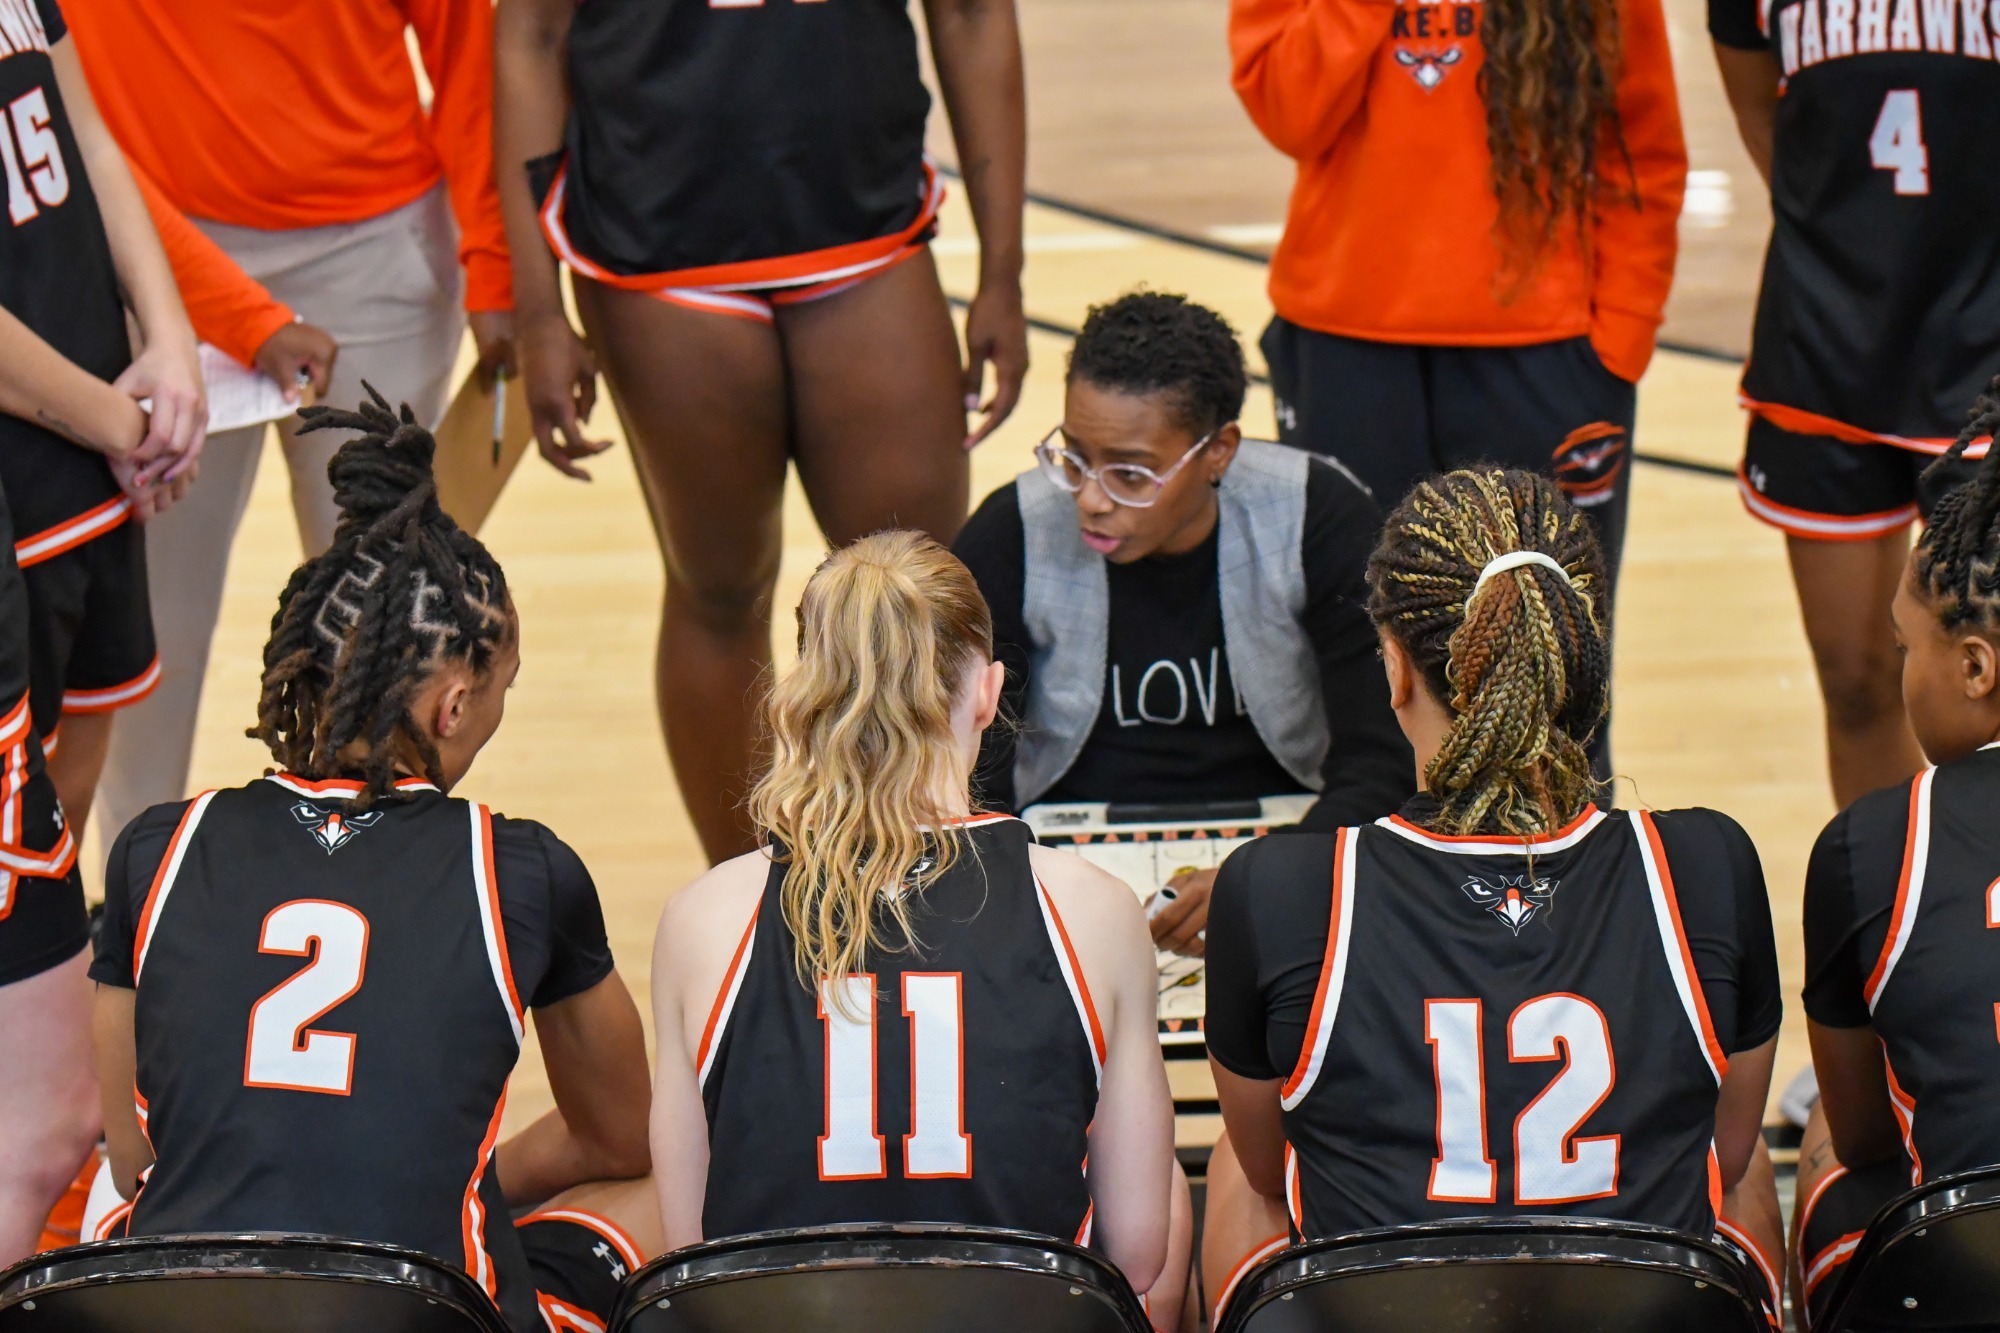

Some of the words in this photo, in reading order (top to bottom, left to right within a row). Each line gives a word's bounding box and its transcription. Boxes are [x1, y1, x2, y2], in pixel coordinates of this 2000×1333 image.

[0, 86, 69, 227] 15
[1869, 88, 1930, 195] 4
[244, 899, 370, 1096] 2
[817, 972, 972, 1181] 11
[1424, 992, 1620, 1205] 12
